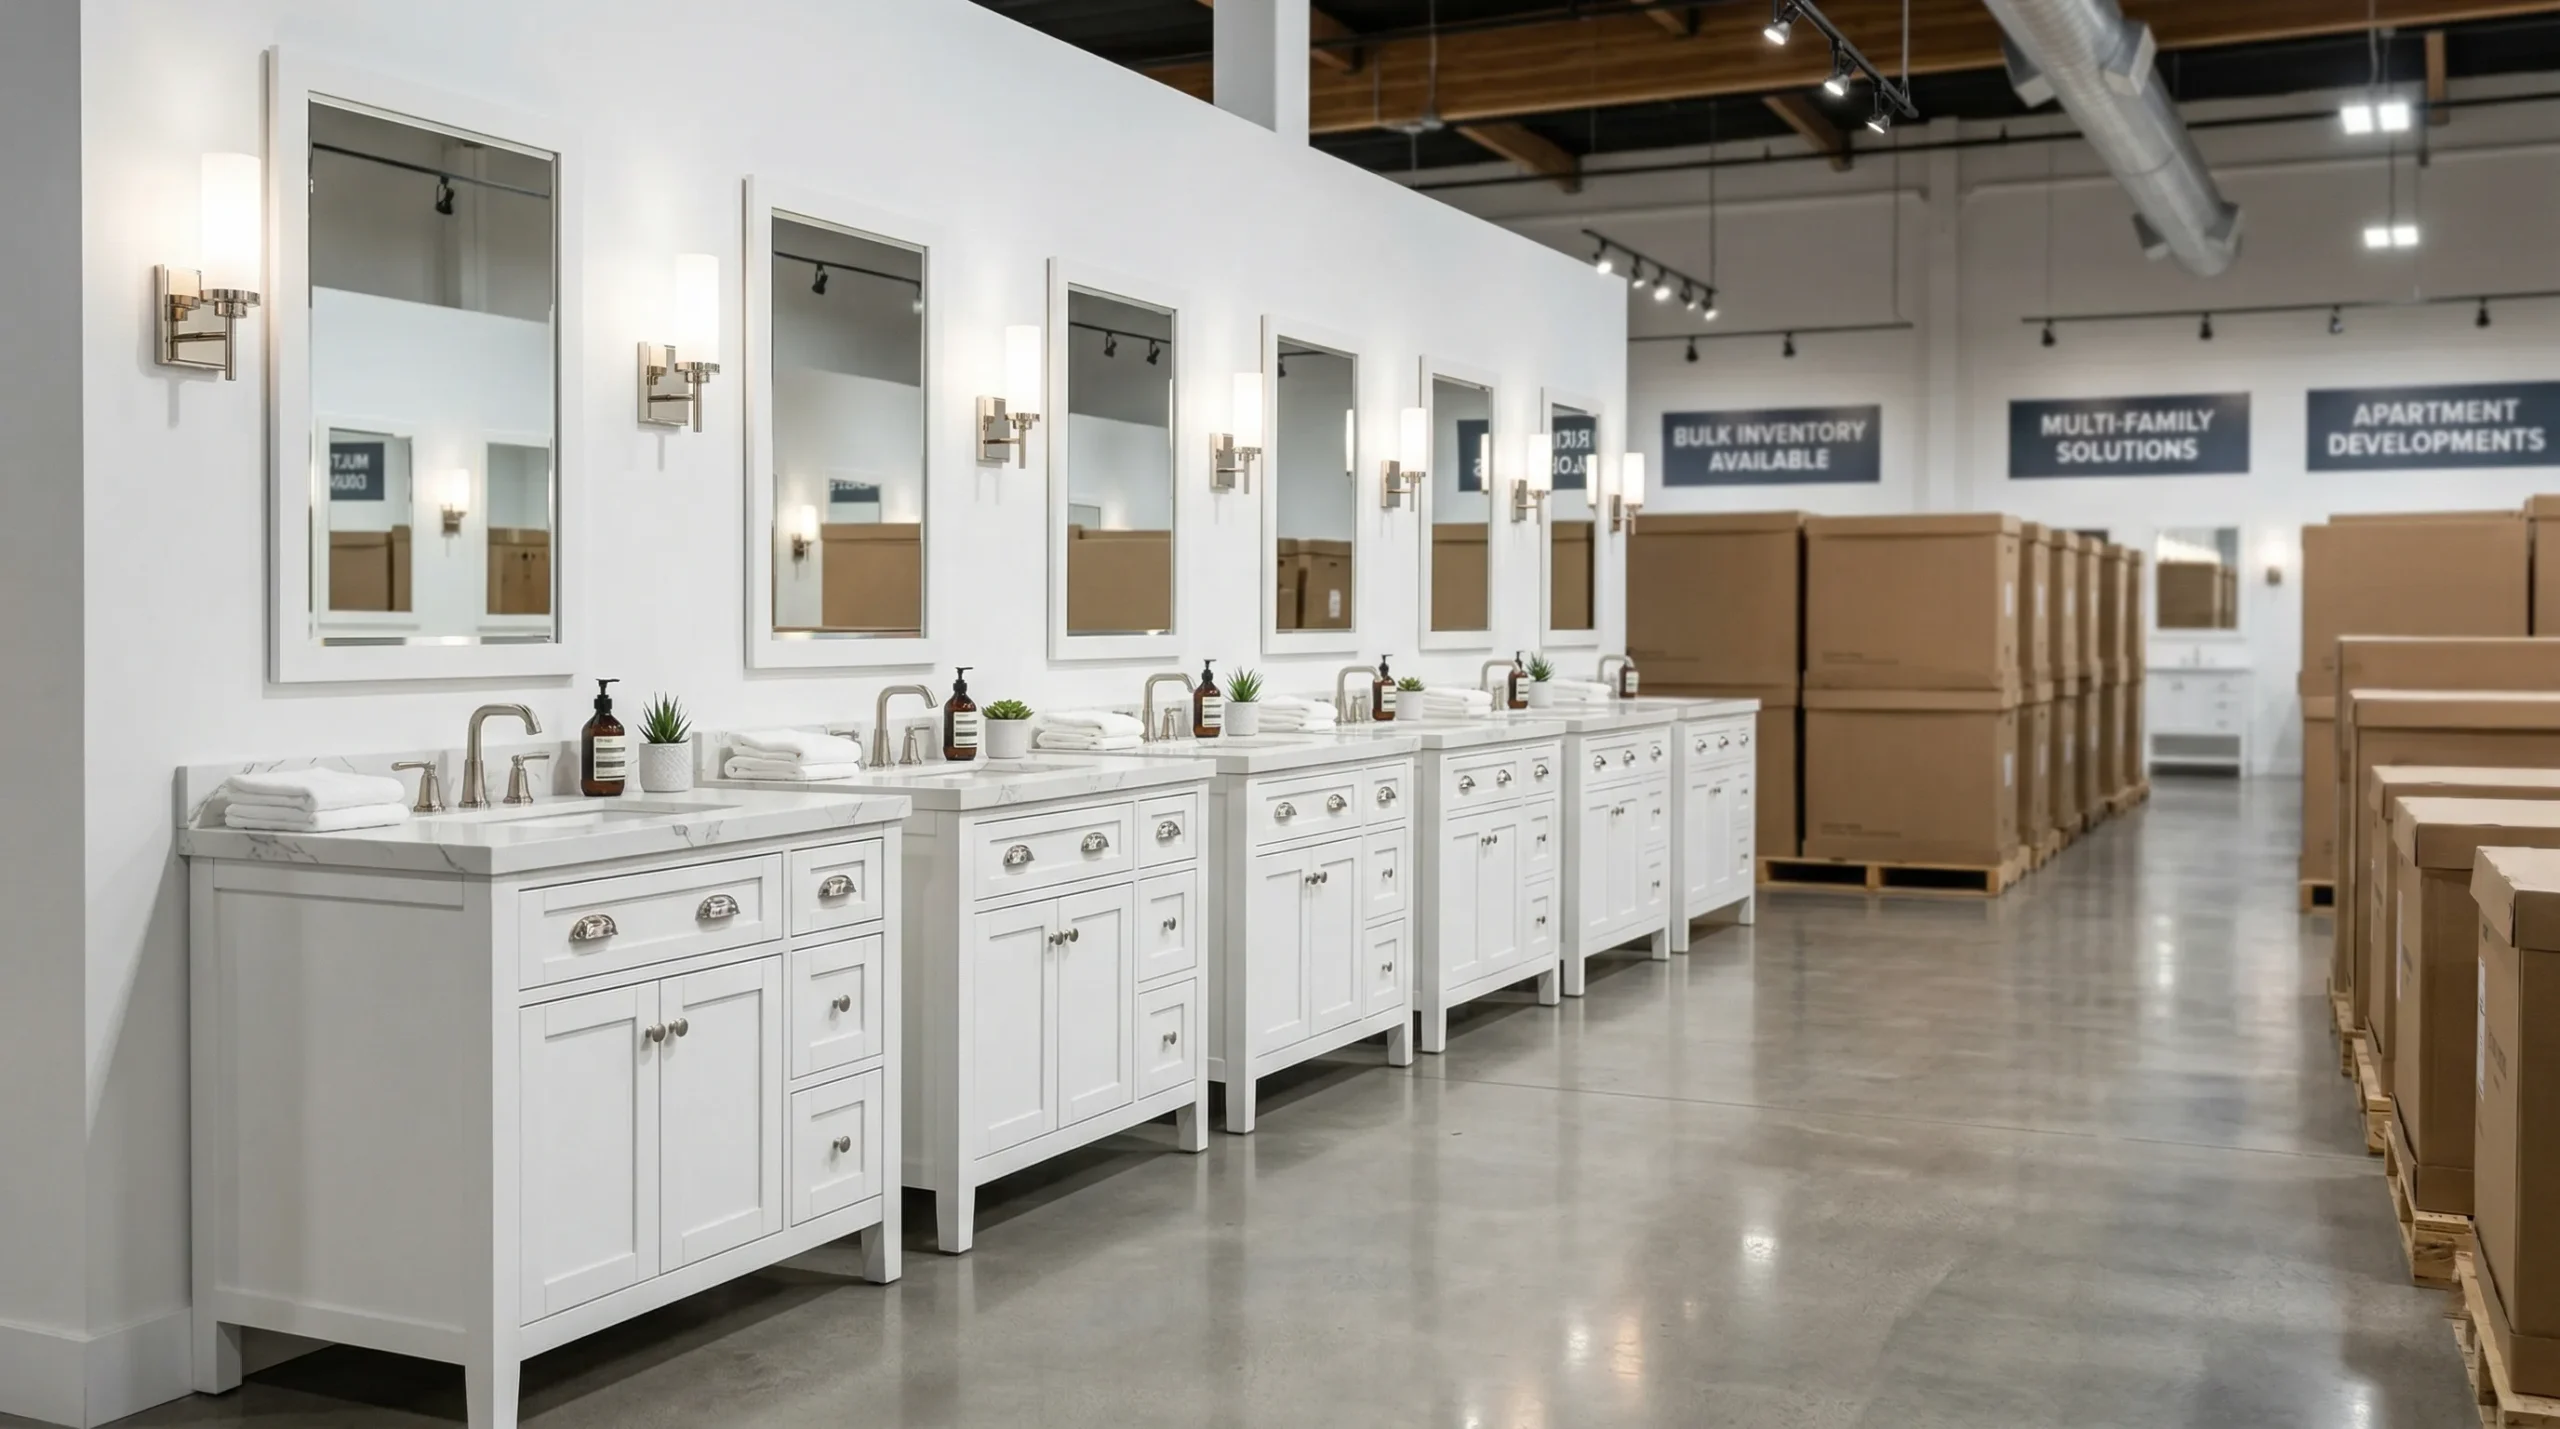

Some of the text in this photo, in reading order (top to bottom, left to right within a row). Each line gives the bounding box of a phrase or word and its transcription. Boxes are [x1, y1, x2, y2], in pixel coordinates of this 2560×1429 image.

[2041, 409, 2215, 436] MULTI-FAMILY
[2353, 398, 2520, 427] APARTMENT
[1673, 420, 1867, 447] BULK INVENTORY
[2328, 427, 2546, 456] DEVELOPMENTS
[1709, 448, 1830, 472] AVAILABLE
[2056, 438, 2198, 464] SOLUTIONS
